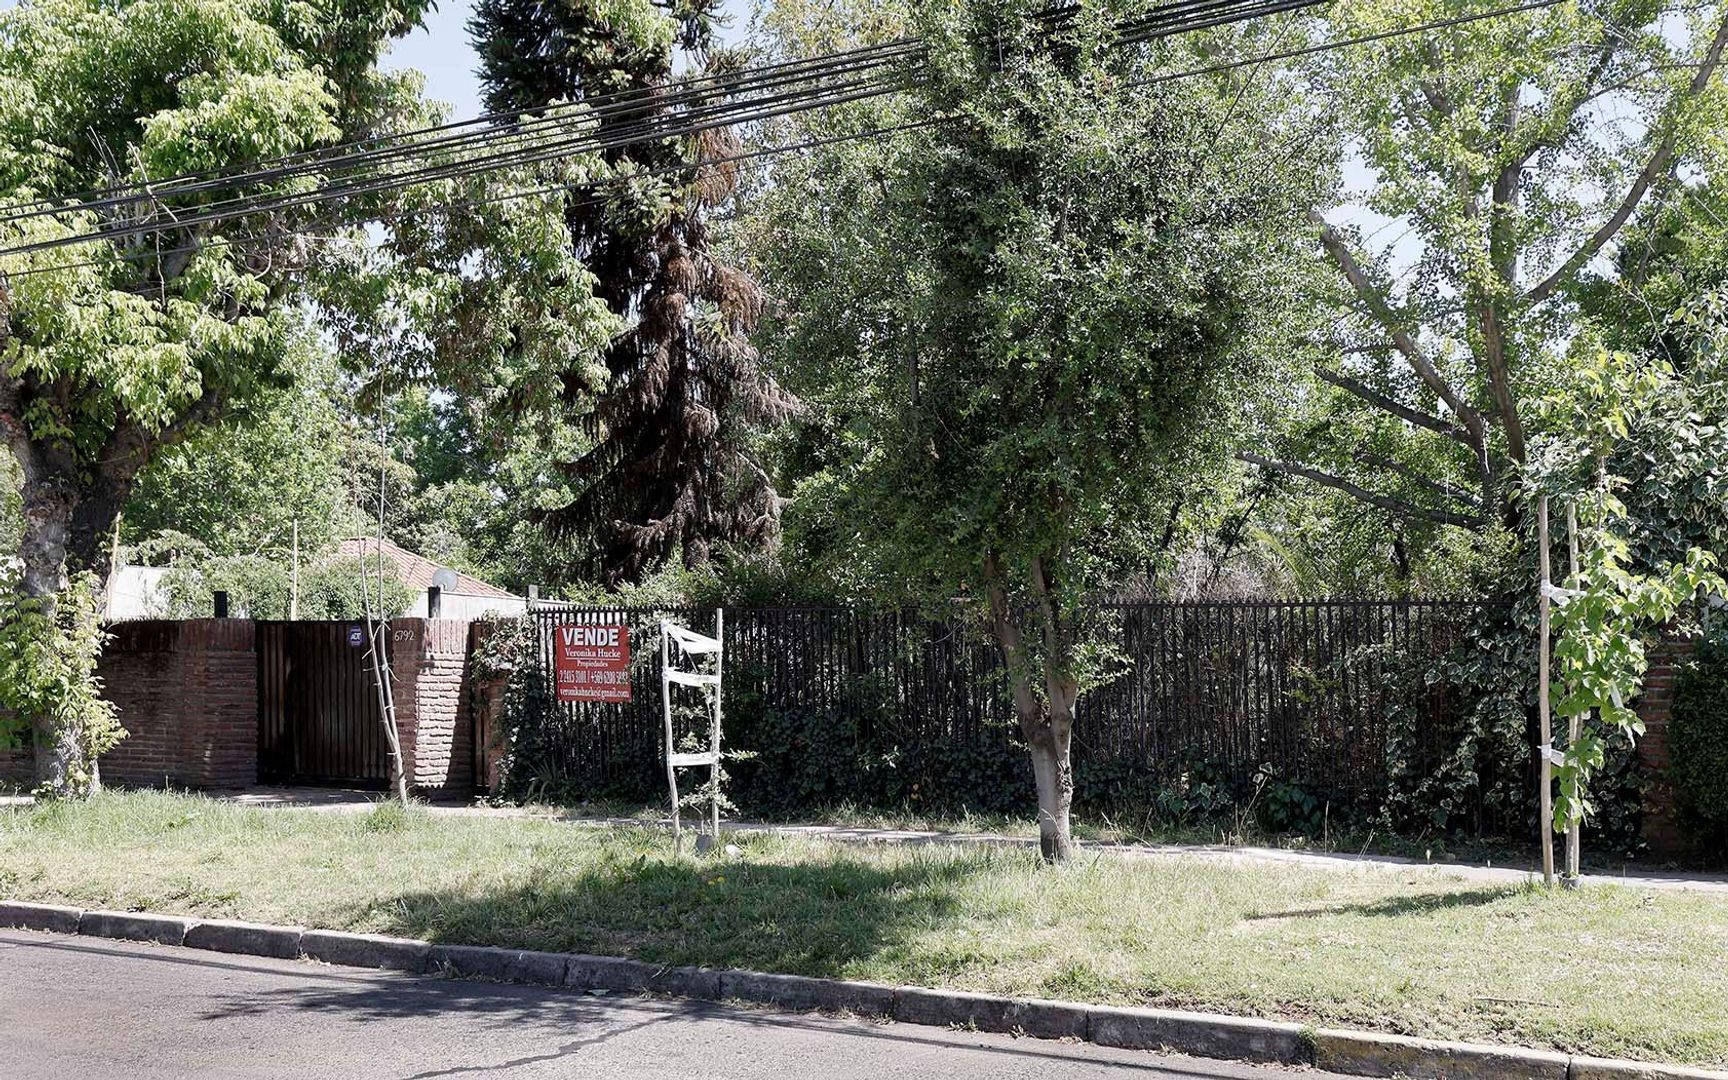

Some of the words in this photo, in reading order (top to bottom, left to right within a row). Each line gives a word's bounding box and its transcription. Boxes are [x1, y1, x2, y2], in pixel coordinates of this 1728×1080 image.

[350, 632, 361, 640] ADT
[394, 630, 415, 641] 6792
[562, 628, 619, 646] VENDE
[565, 648, 596, 657] Veronika
[597, 648, 621, 658] Hucke
[577, 660, 608, 669] Propiedades
[559, 670, 563, 683] 2
[591, 671, 603, 684] +569
[560, 687, 629, 700] veronikahucke@gmail.com
